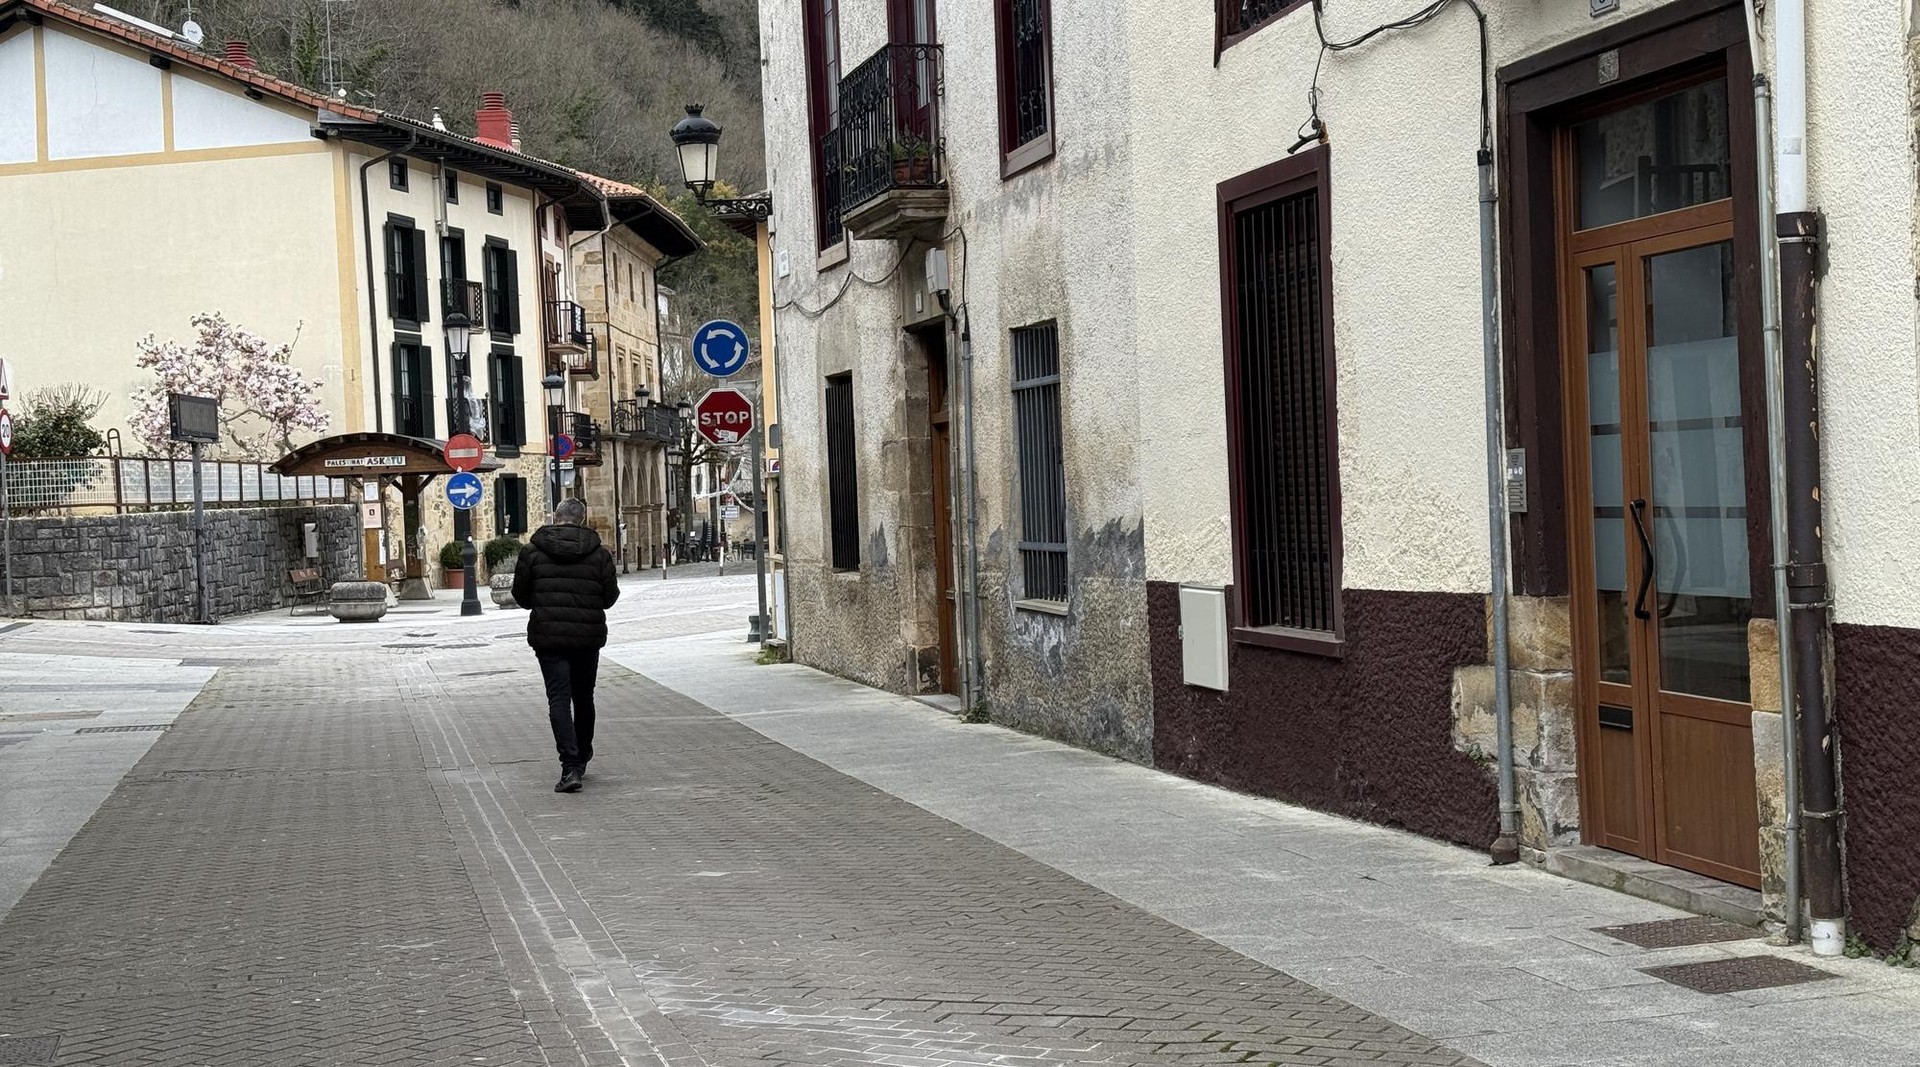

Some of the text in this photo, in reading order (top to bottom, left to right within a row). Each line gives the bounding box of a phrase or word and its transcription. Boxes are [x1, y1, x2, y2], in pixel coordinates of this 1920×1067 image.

[701, 411, 749, 425] STOP
[2, 423, 10, 438] 20
[367, 456, 403, 465] ASKATU
